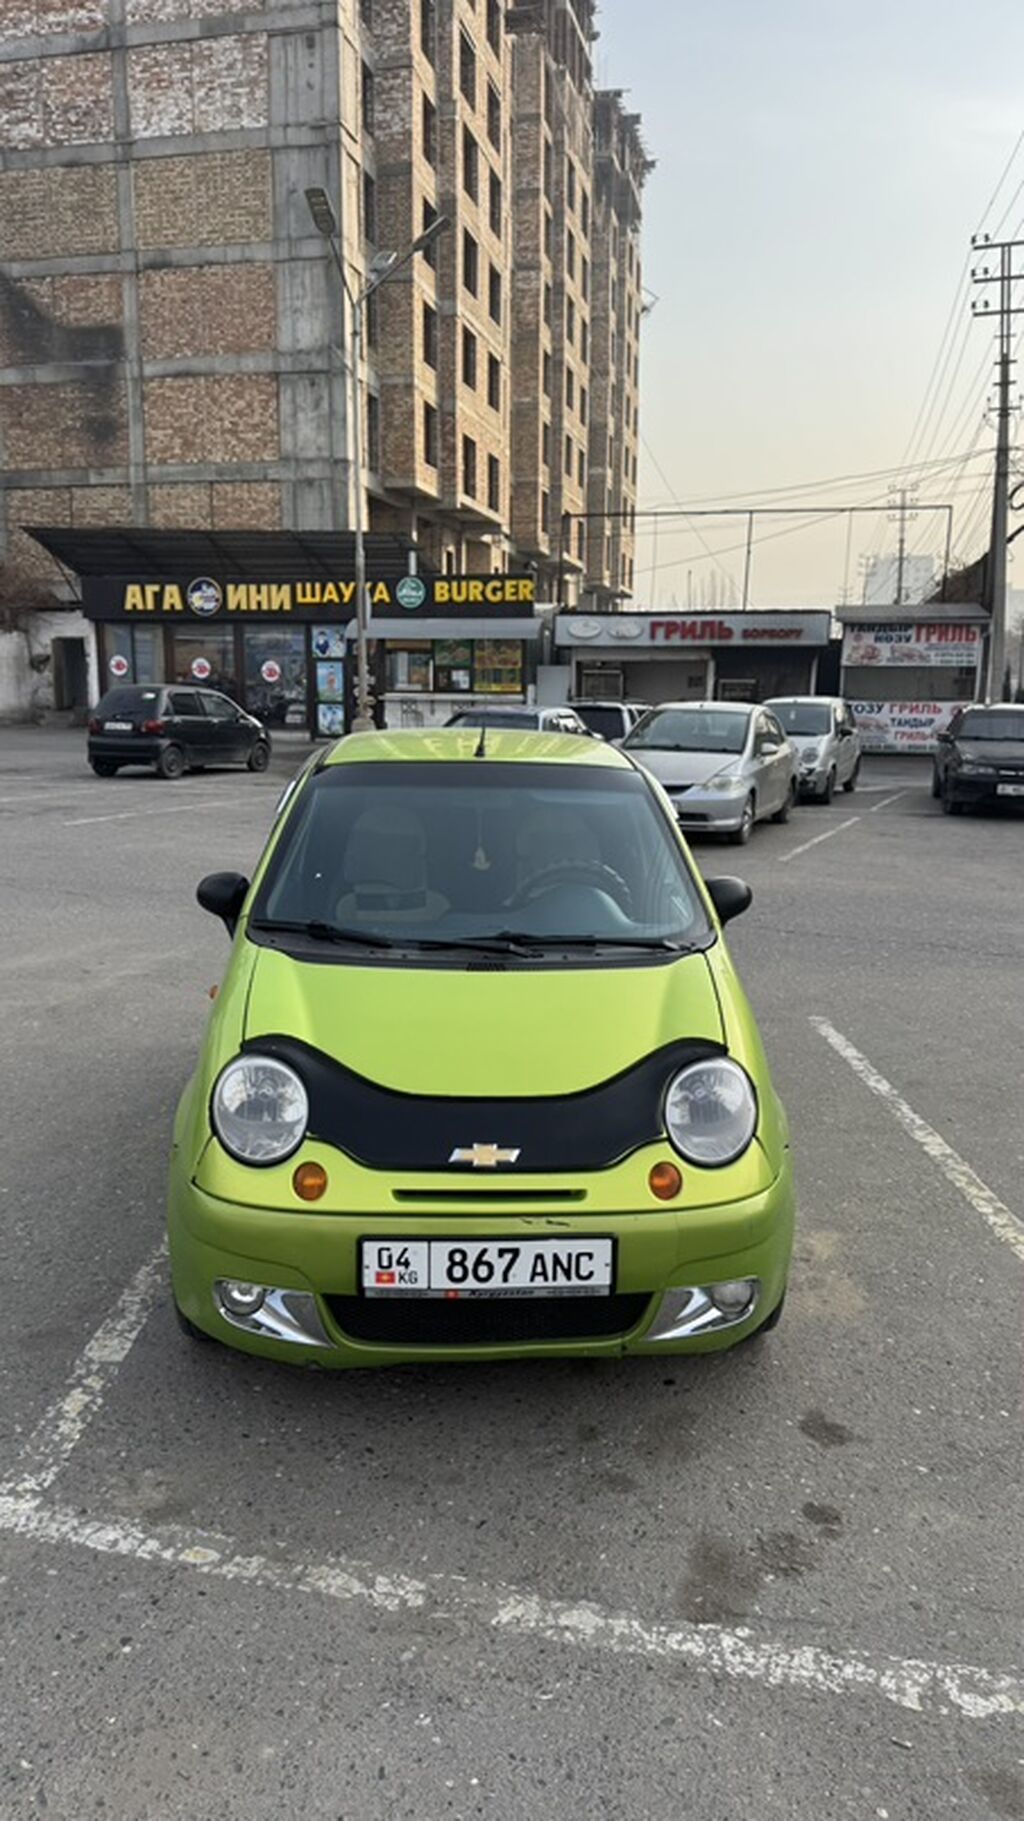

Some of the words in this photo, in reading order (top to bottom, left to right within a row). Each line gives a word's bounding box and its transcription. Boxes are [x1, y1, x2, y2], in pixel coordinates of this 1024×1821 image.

[124, 584, 183, 611] АГА
[226, 584, 291, 611] ИНИ
[434, 579, 535, 602] BURGER
[650, 620, 734, 641] ГРИЛЬ
[915, 624, 977, 643] ГРИЛЬ
[889, 704, 942, 714] ГРИЛЬ
[890, 717, 935, 728] ТАНДЫР
[377, 1247, 411, 1270] 04
[446, 1247, 520, 1284] 867
[529, 1251, 594, 1283] ANC
[398, 1271, 418, 1285] KG
